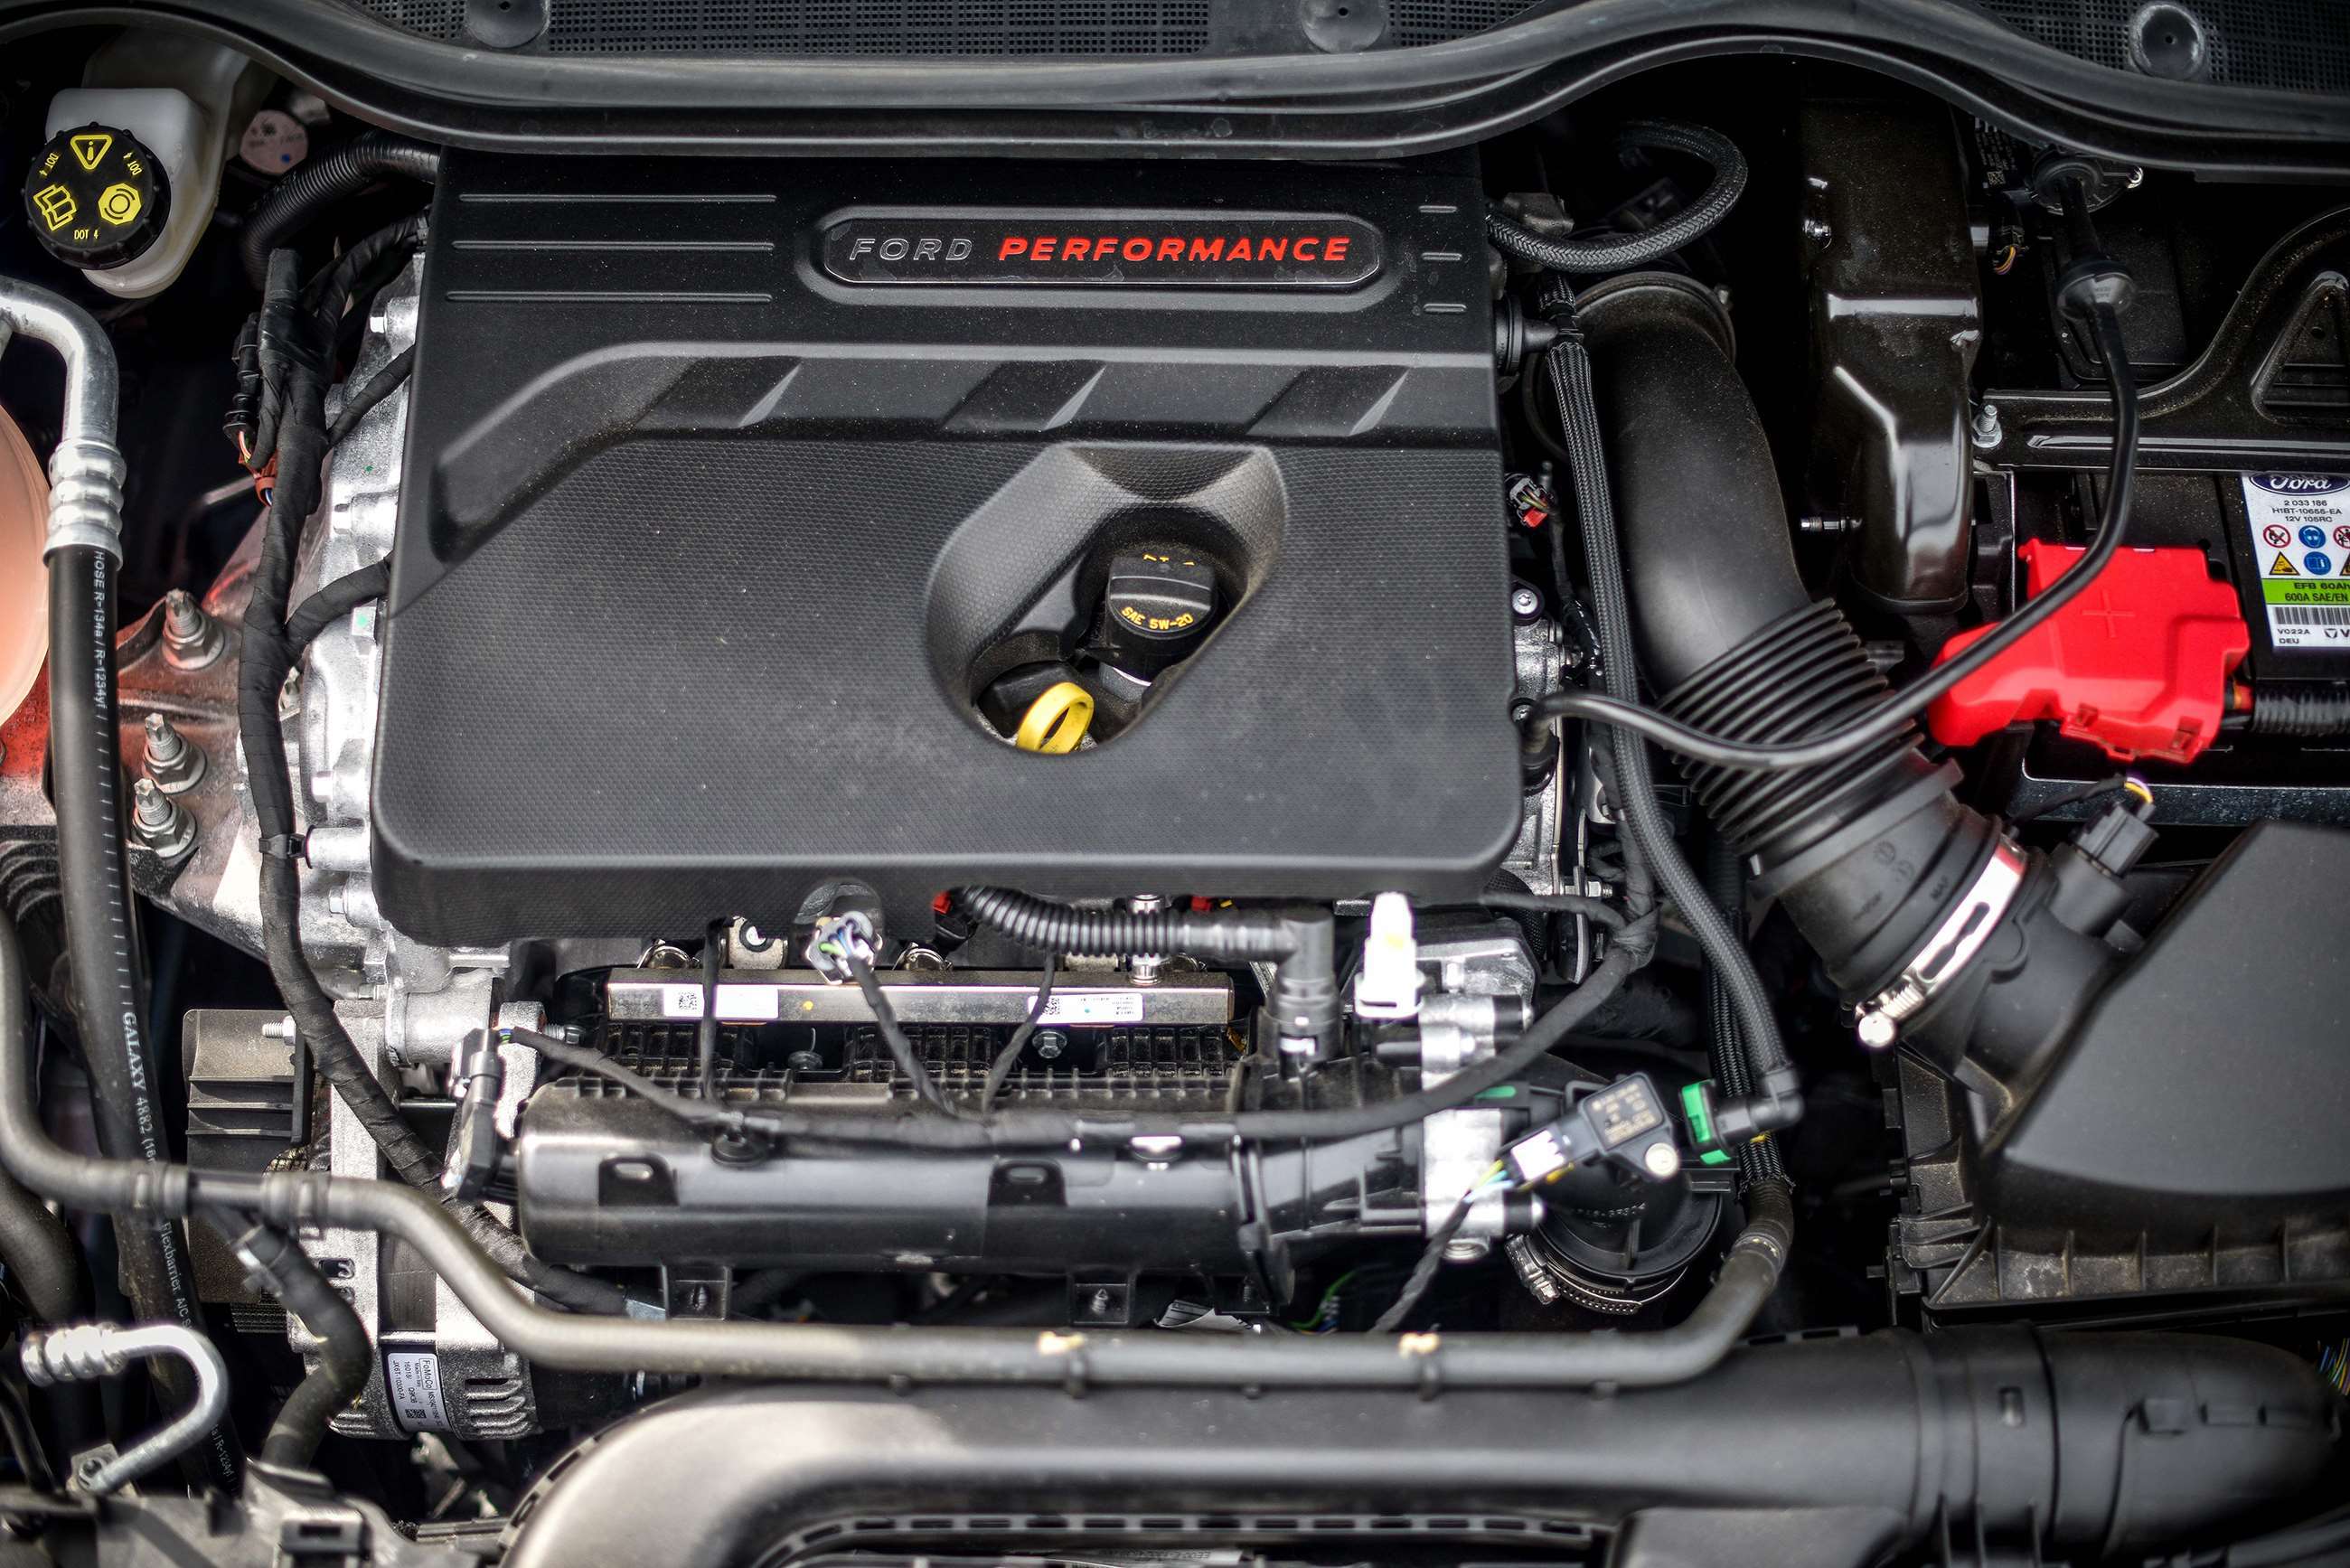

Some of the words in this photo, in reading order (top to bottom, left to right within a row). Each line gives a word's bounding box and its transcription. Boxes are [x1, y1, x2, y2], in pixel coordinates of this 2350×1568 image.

[74, 230, 89, 239] DOT
[93, 230, 99, 239] 4
[849, 238, 973, 261] FORD
[997, 236, 1350, 263] PERFORMANCE
[93, 550, 106, 590] HOSE
[2285, 593, 2310, 601] 600A
[2313, 592, 2348, 602] SAE/EN
[1121, 606, 1146, 625] SAE
[1148, 613, 1195, 630] 5W-20
[122, 1011, 147, 1092] GALAXY
[136, 1096, 154, 1134] 4882
[422, 1359, 434, 1389] FoMoCo
